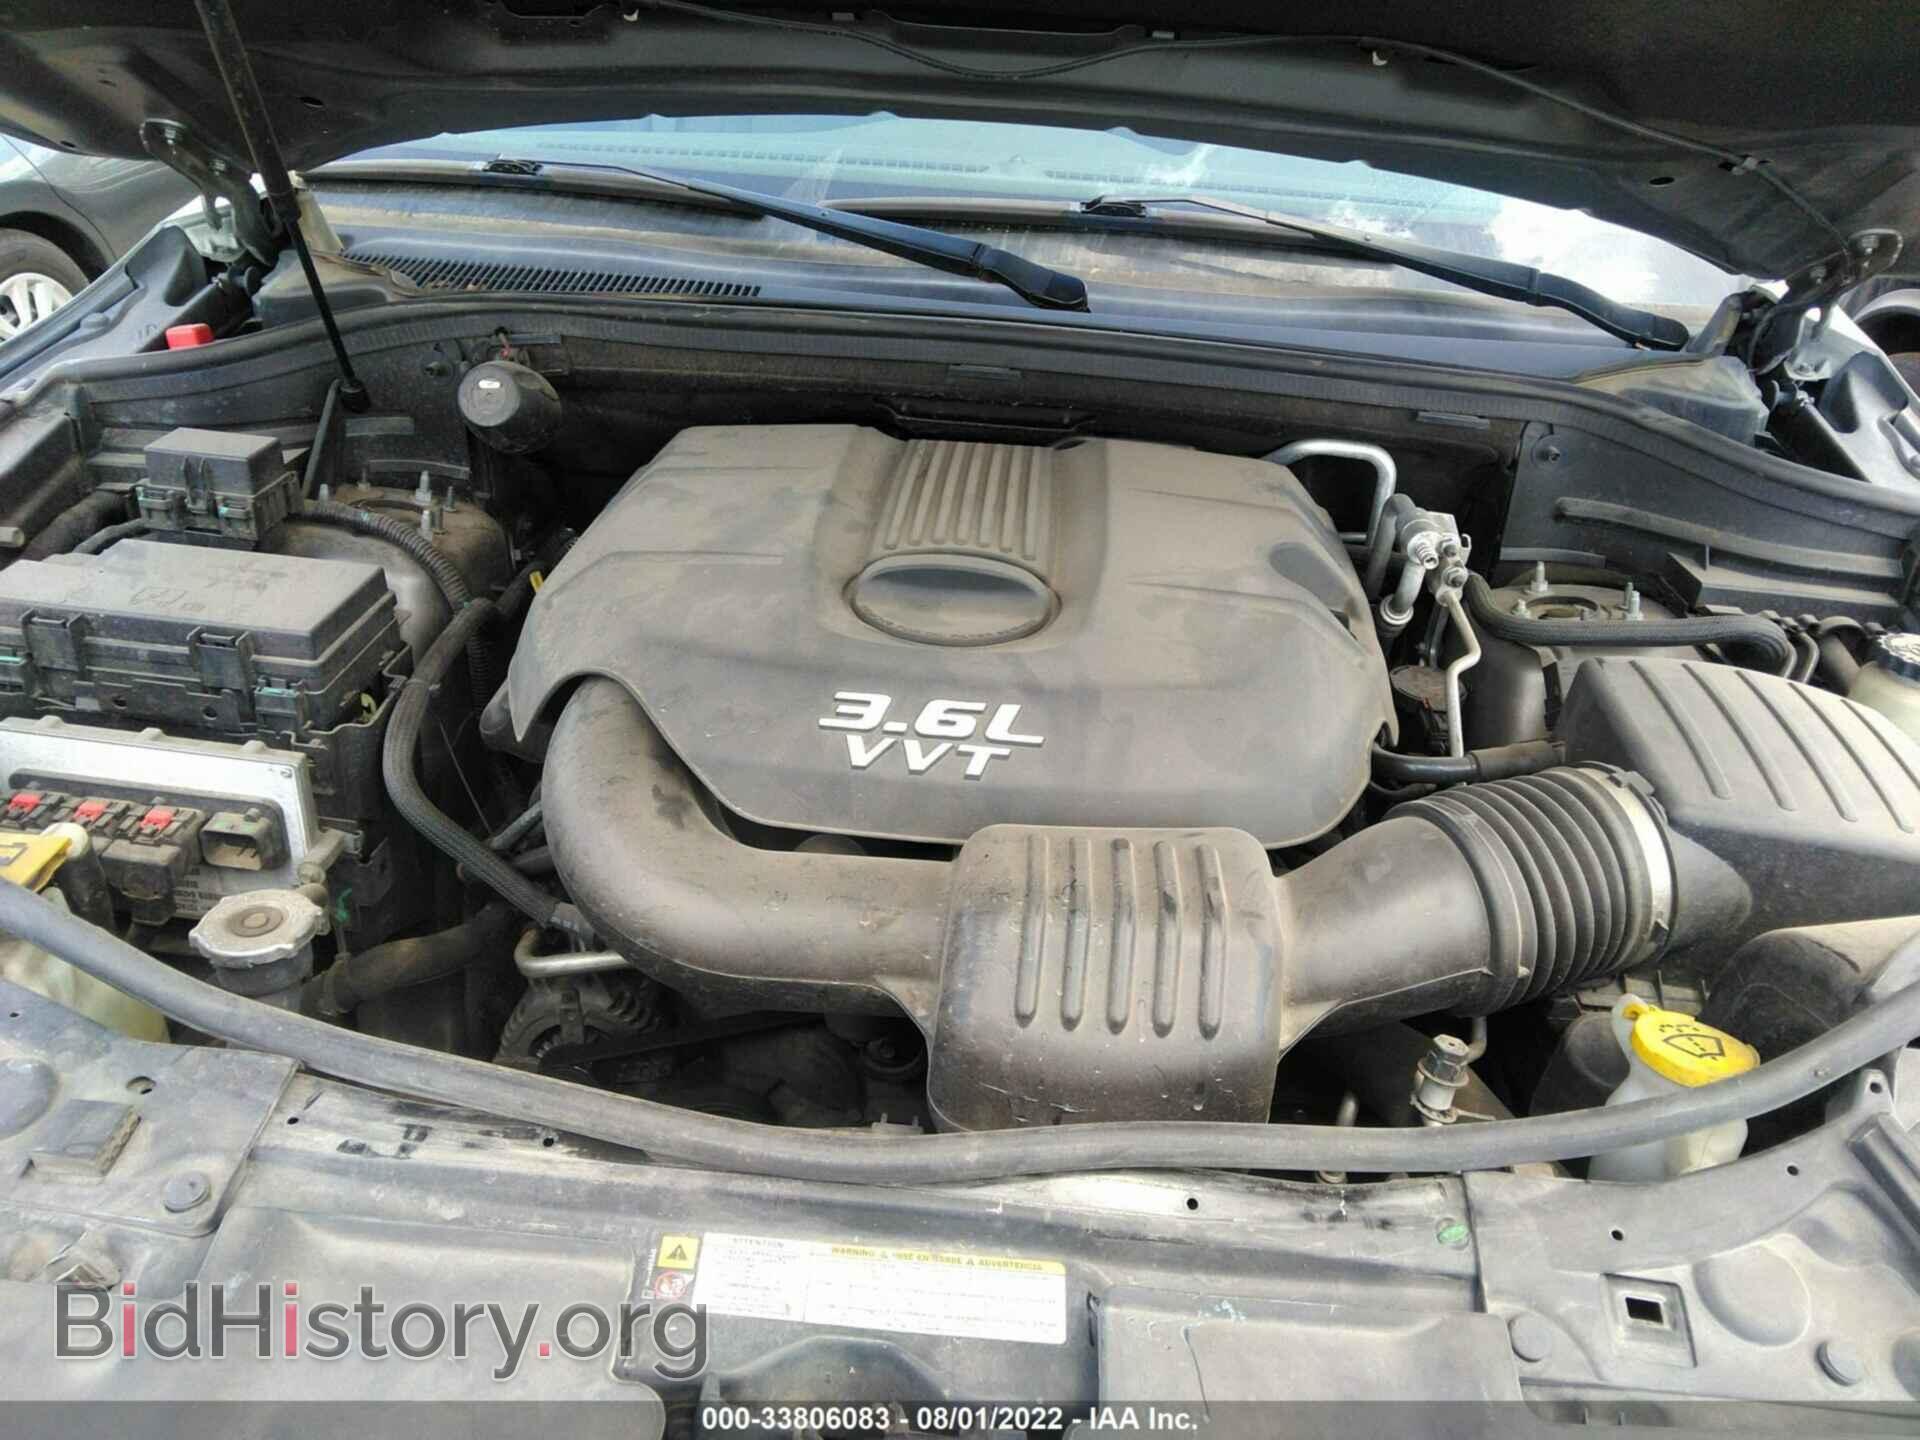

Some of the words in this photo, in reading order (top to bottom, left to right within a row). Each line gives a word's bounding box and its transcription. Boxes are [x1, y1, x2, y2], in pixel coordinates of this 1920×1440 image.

[818, 690, 1046, 746] 3.6L
[845, 734, 1013, 780] VVT
[832, 1246, 875, 1257] WARNING
